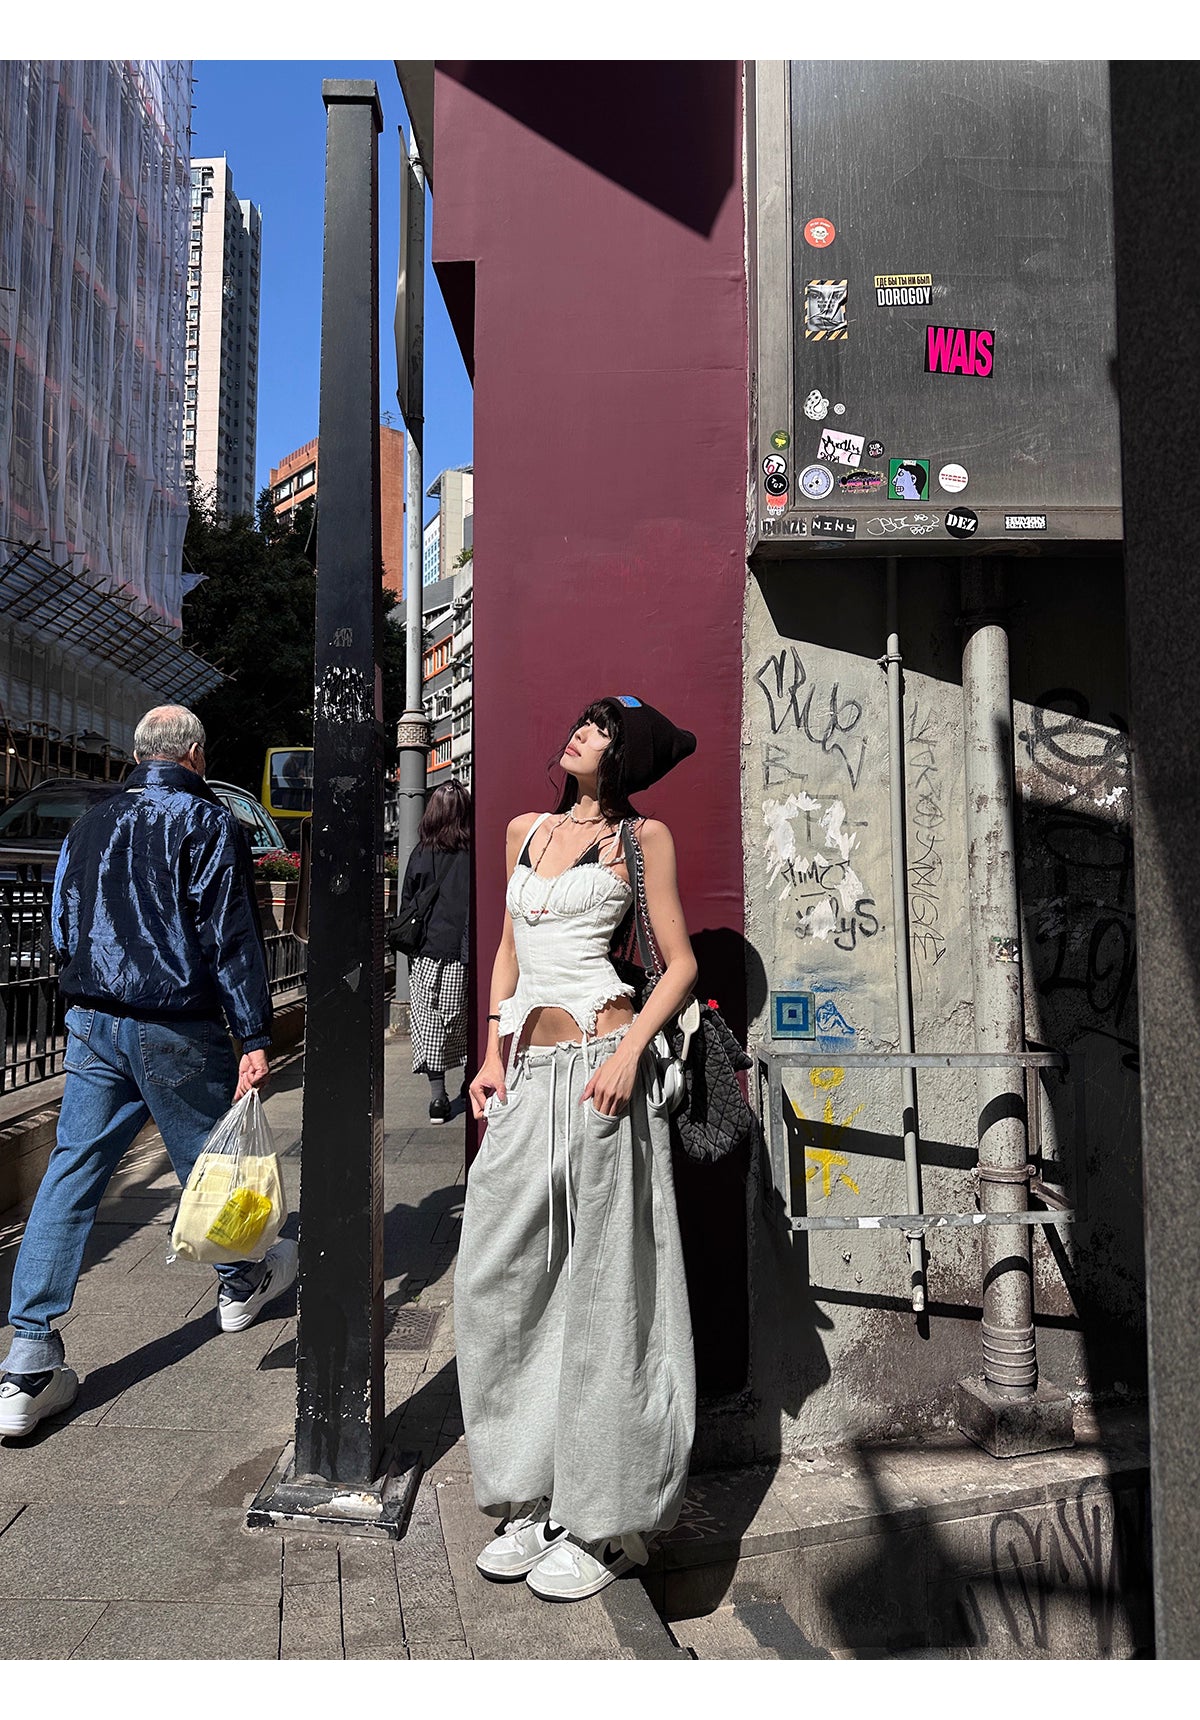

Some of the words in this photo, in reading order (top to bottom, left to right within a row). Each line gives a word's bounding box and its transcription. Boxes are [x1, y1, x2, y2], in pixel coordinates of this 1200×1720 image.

[876, 277, 887, 287] ГДЕ
[877, 287, 930, 305] DOROGOY
[927, 326, 994, 377] WAIS
[946, 513, 977, 532] DEZ
